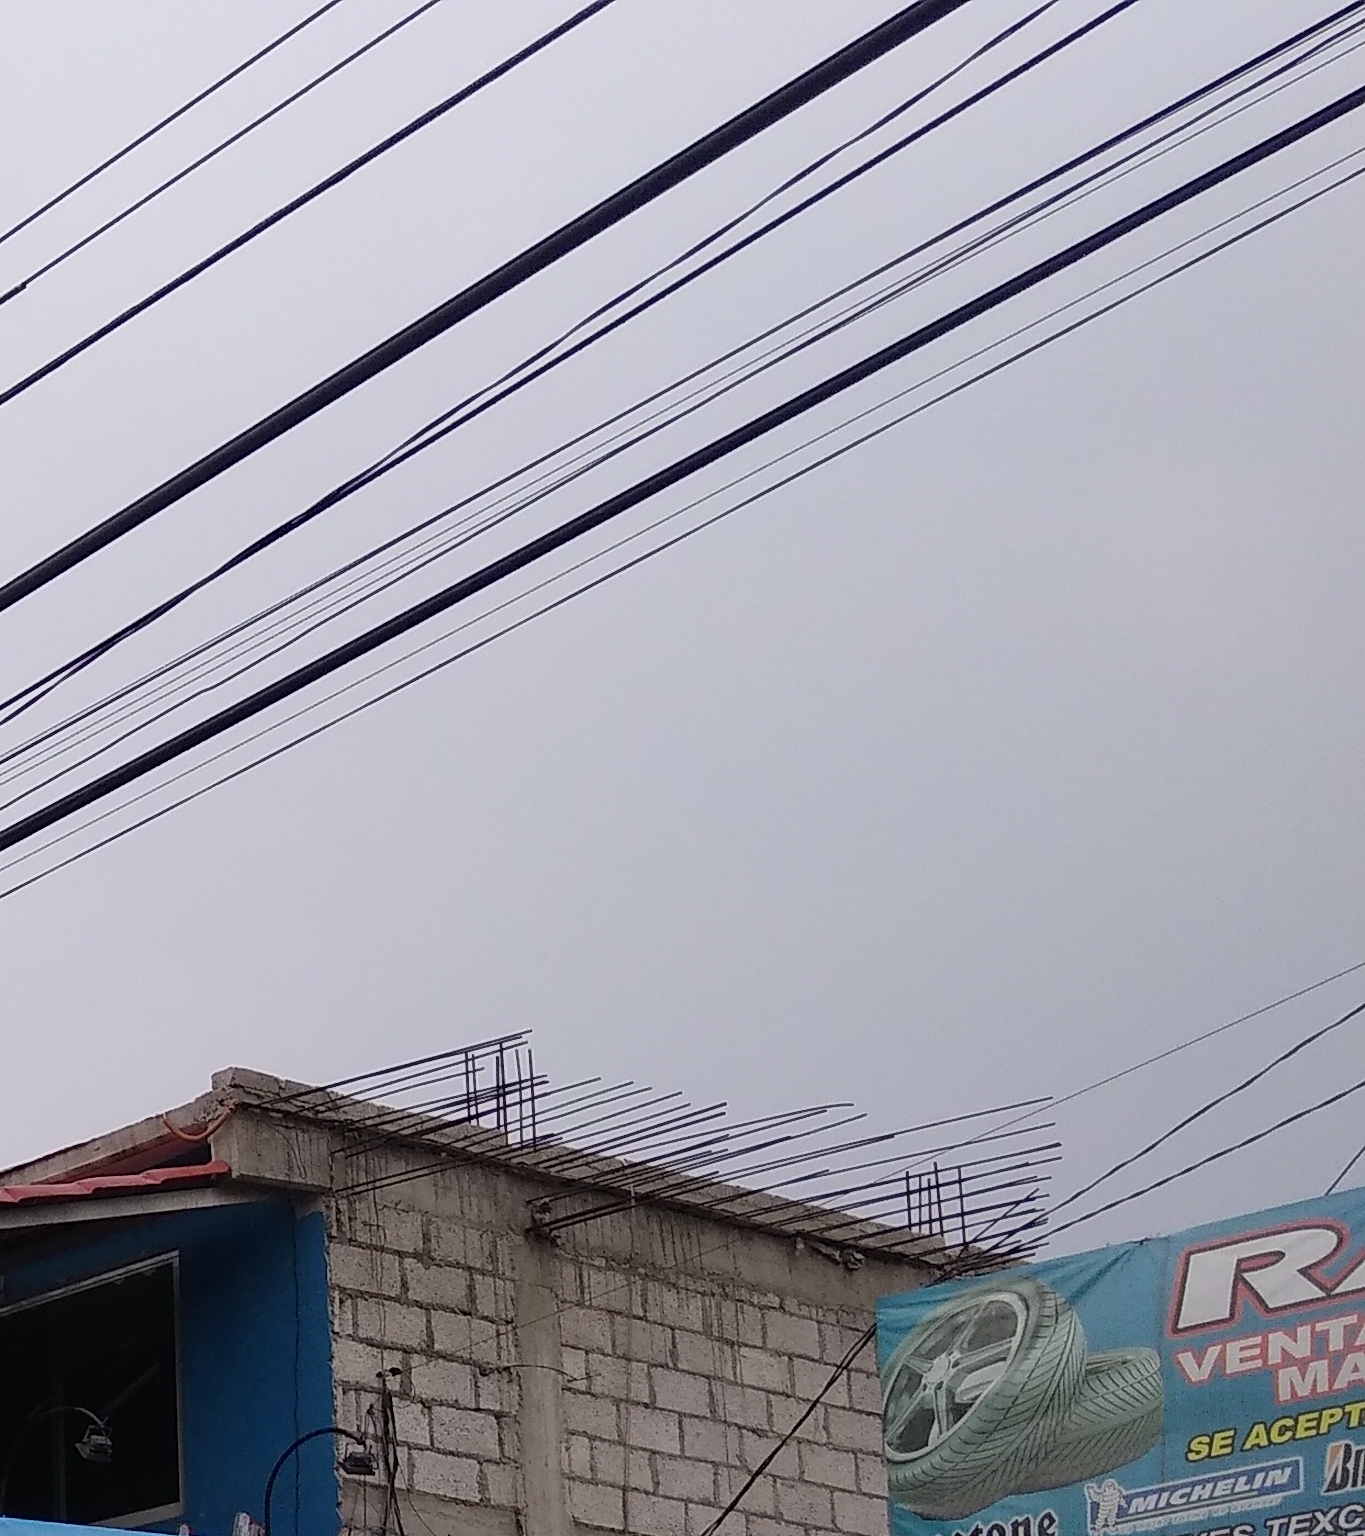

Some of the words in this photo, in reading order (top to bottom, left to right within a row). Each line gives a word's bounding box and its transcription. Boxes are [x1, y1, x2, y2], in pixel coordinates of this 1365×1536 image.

[1172, 1225, 1365, 1333] R
[1176, 1313, 1365, 1383] VENT
[1186, 1427, 1236, 1462] SE
[1126, 1466, 1294, 1515] MICHELIN
